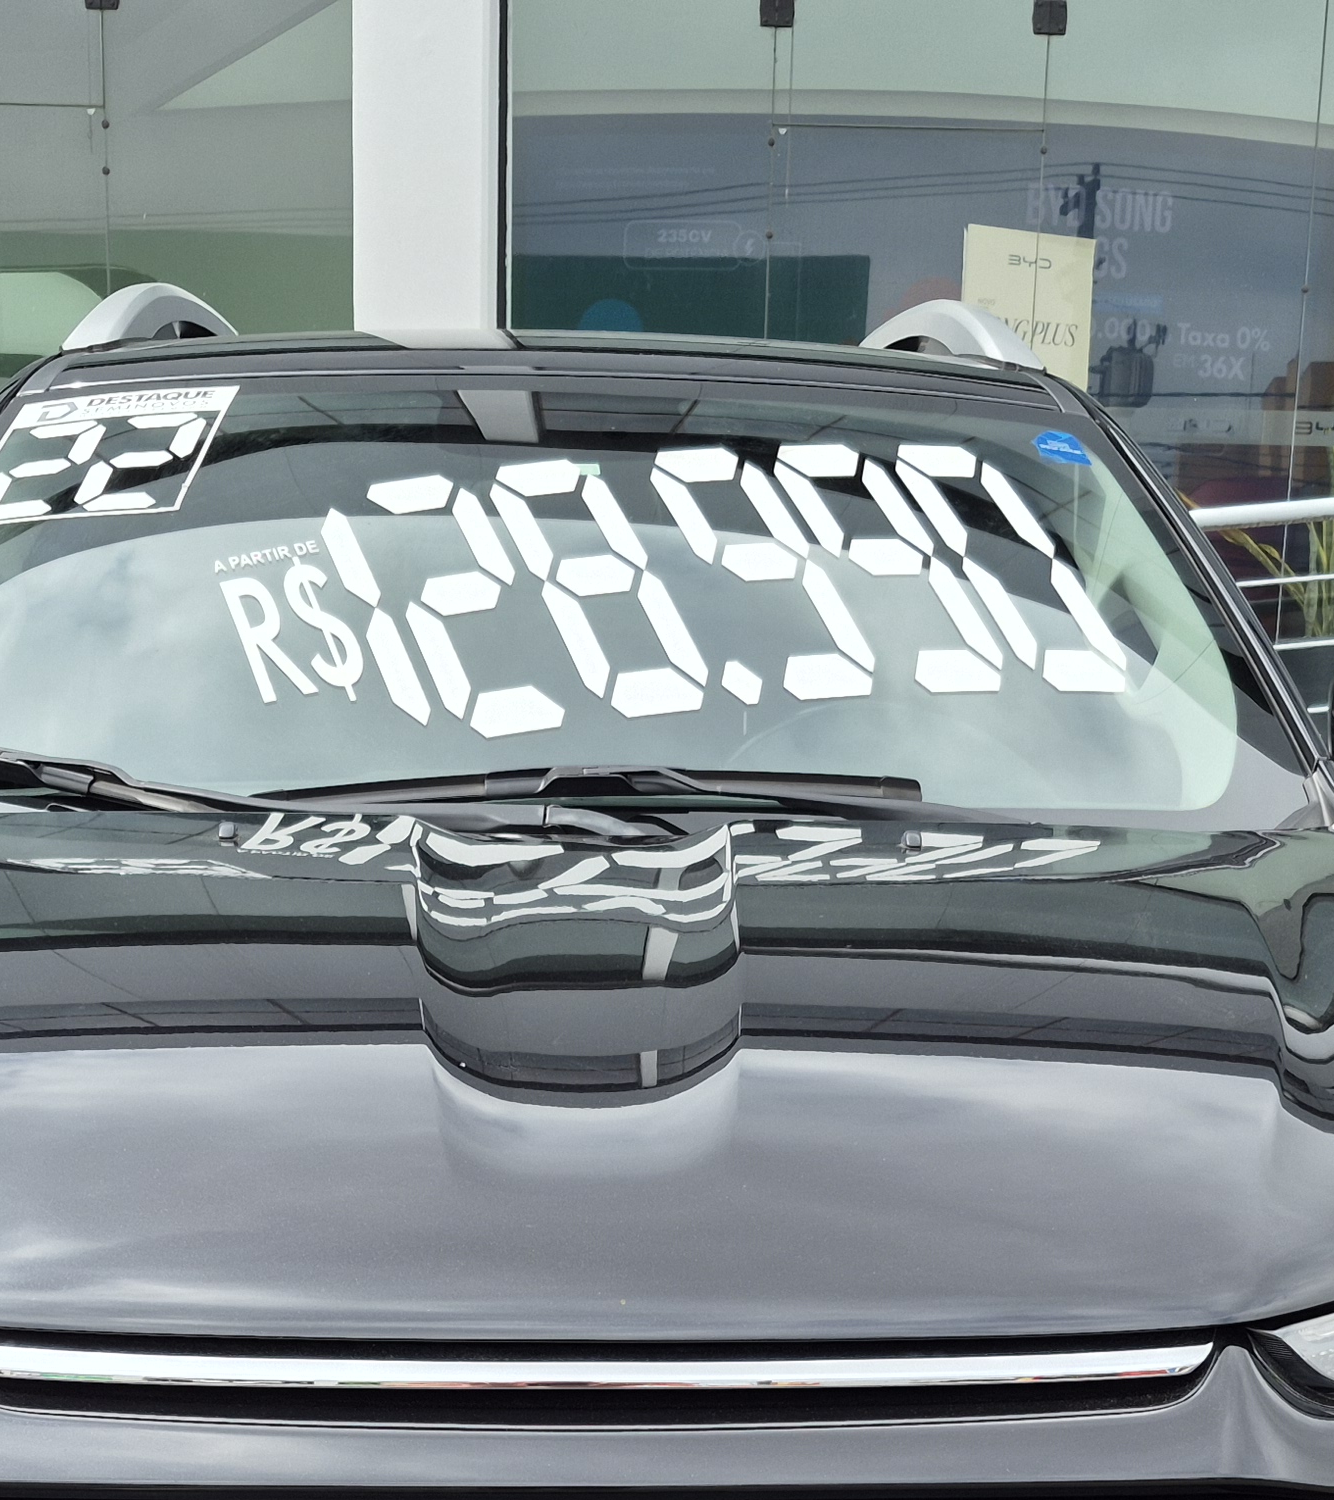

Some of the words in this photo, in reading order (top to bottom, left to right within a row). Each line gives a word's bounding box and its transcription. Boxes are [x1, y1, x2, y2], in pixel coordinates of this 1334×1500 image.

[1095, 188, 1173, 233] SONG
[657, 229, 713, 243] 235CV
[1008, 254, 1052, 269] BYD
[1032, 321, 1078, 348] PLUS
[1177, 322, 1230, 348] Taxa
[1236, 327, 1270, 351] 0%
[1197, 355, 1246, 382] 36X
[87, 390, 215, 407] DESTAQUE
[214, 559, 227, 574] A
[228, 545, 291, 570] PARTIR
[293, 540, 320, 556] DE
[320, 443, 1127, 740] 128.990
